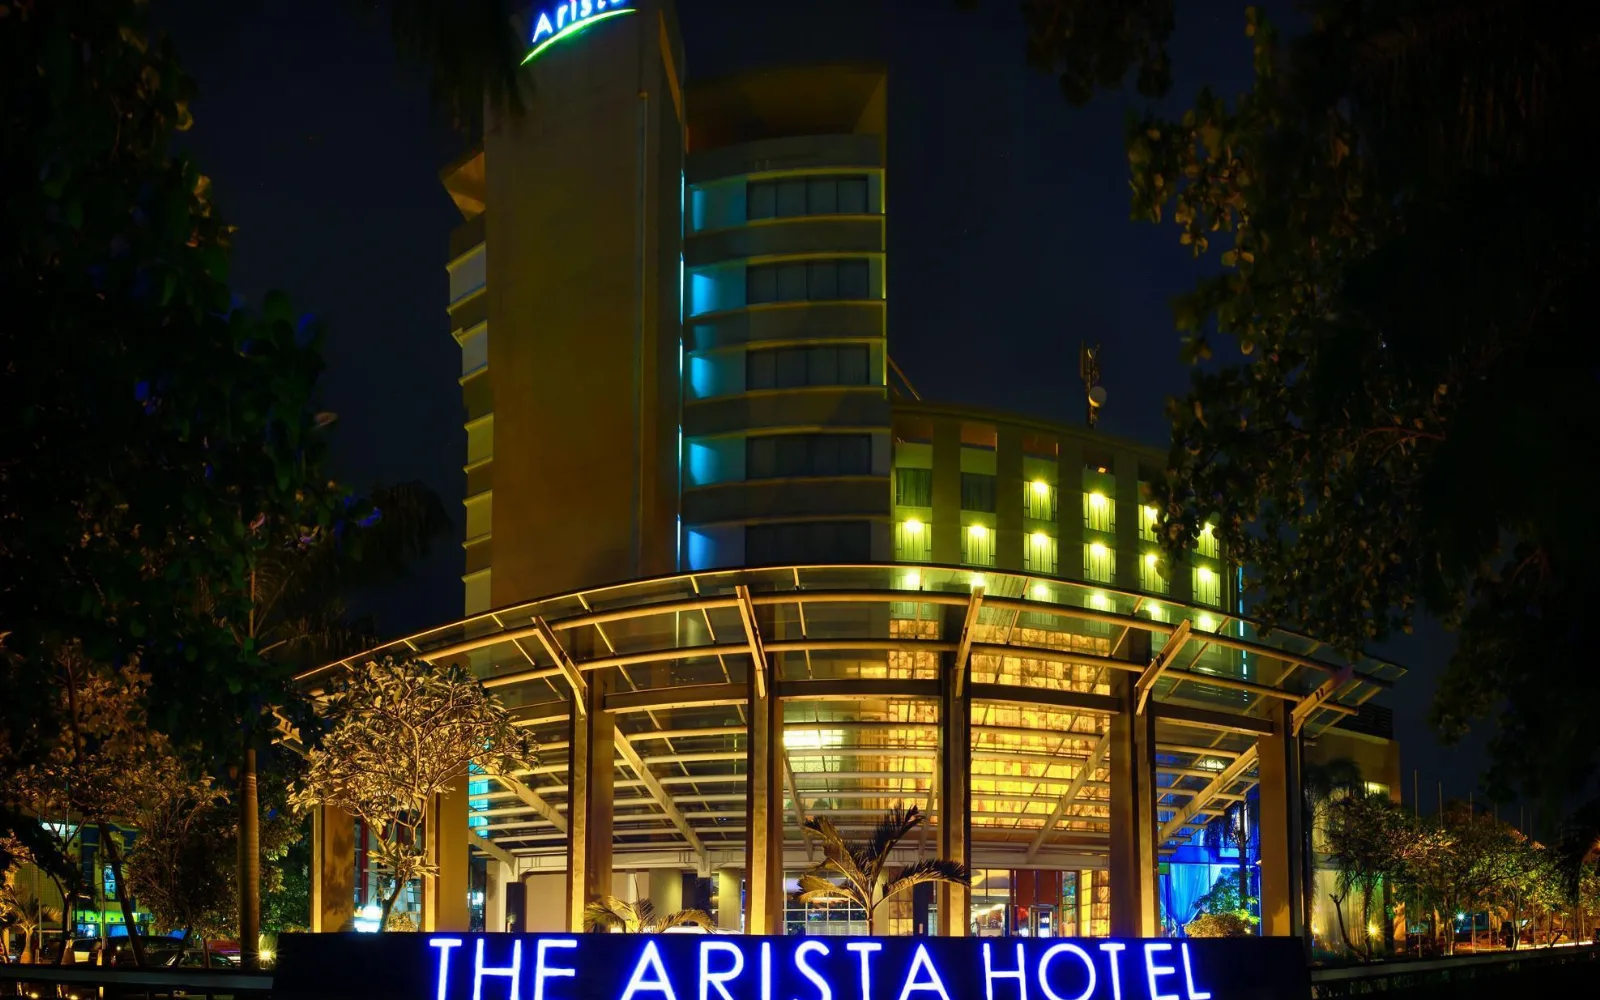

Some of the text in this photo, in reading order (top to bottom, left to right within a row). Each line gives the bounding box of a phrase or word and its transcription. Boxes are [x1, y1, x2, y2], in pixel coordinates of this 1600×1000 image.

[532, 0, 624, 43] Aris
[429, 939, 1211, 1000] THE ARISTA HOTEL
